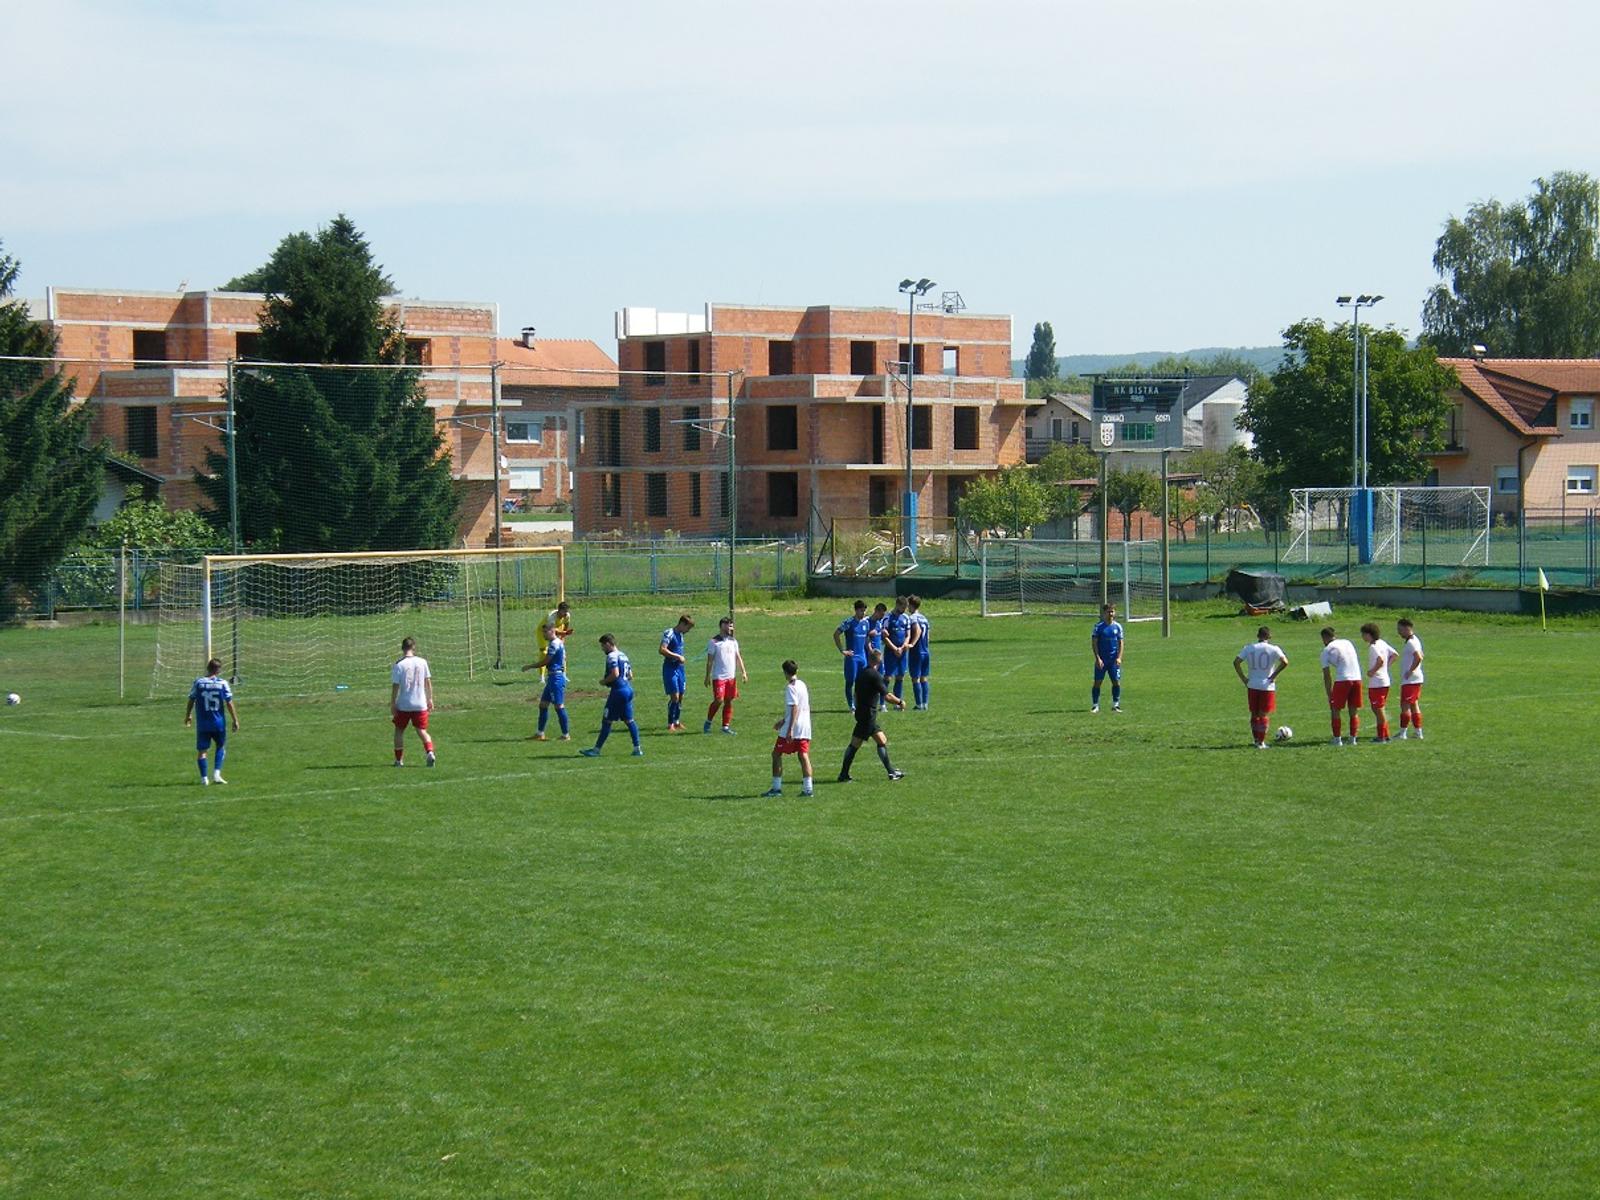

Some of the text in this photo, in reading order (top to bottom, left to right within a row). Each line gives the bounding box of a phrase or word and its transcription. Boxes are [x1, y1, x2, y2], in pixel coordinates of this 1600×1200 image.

[1113, 386, 1159, 395] NK BISTRA
[1248, 651, 1270, 671] 10
[201, 691, 220, 711] 15
